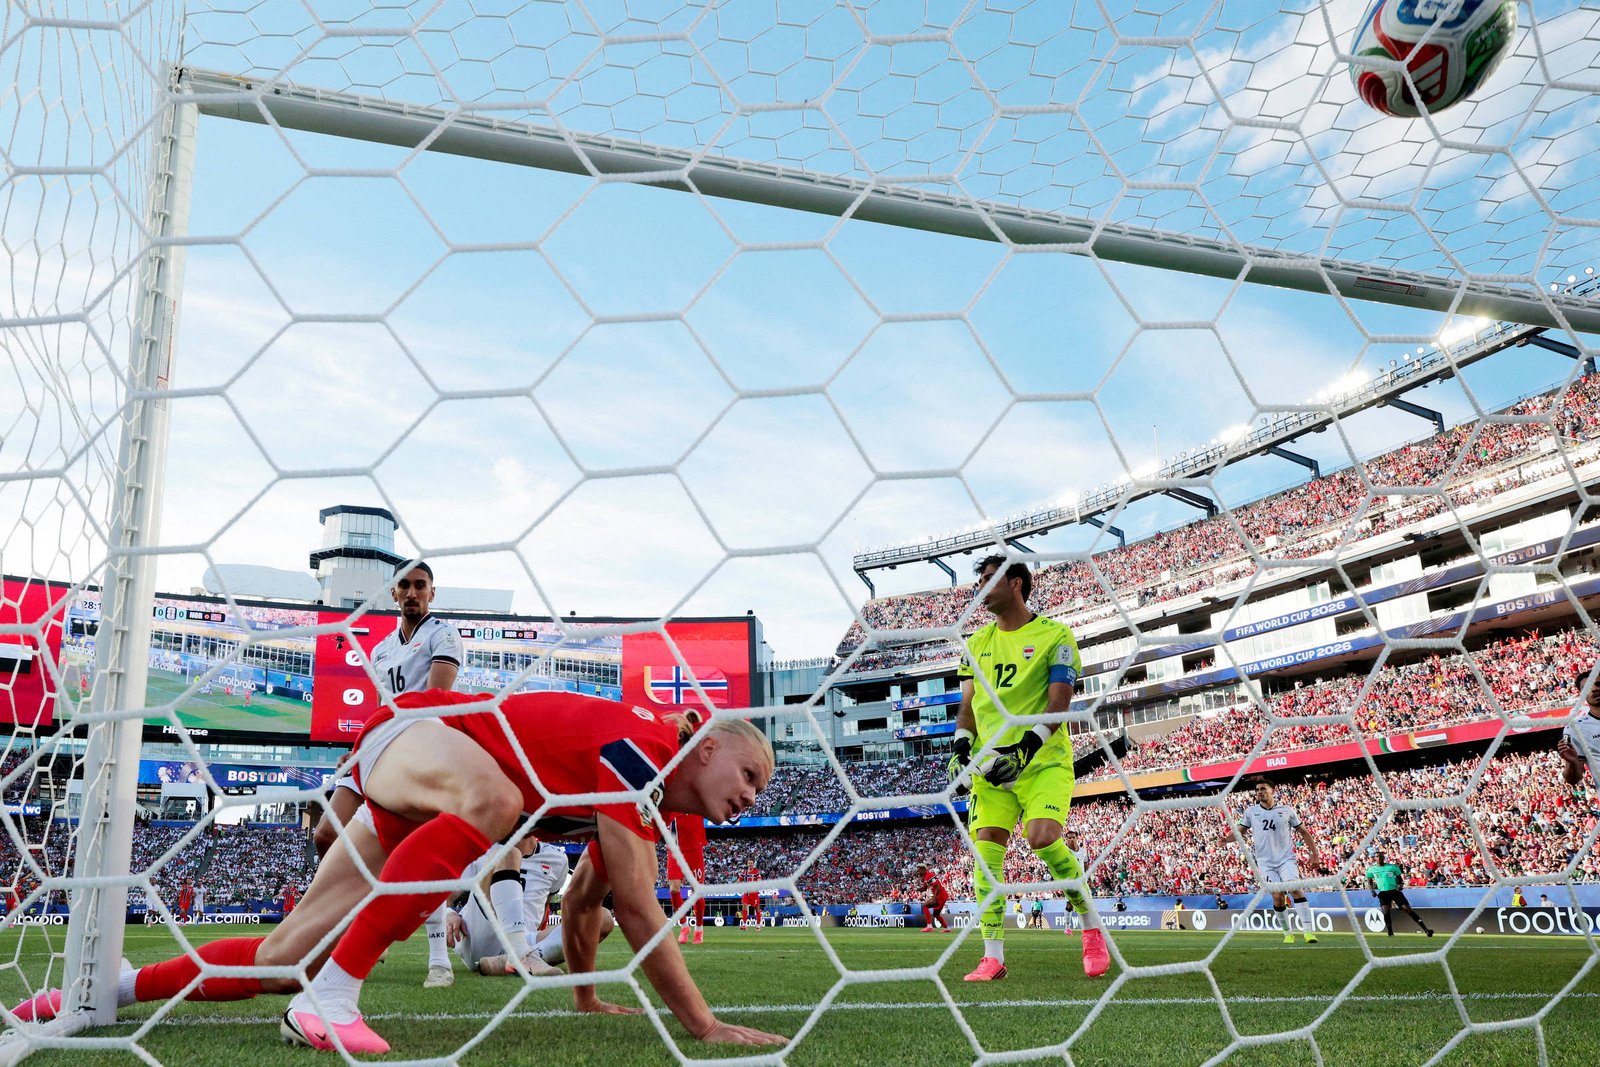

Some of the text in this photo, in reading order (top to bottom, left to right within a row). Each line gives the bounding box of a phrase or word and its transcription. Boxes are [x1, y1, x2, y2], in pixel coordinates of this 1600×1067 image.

[1489, 543, 1547, 567] BOSTON
[1496, 591, 1556, 615] BOSTON
[1235, 600, 1347, 637] FIFA WORLD CUP 2026
[1240, 641, 1352, 674] FIFA WORLD CUP 2026
[218, 675, 256, 690] motorola
[388, 665, 405, 694] 16
[994, 663, 1017, 689] 12
[1106, 690, 1139, 703] BOSTON
[162, 725, 209, 736] Hisnse
[1266, 756, 1287, 767] IRAQ
[228, 770, 288, 783] BOSTON
[1044, 804, 1060, 812] JAKO
[857, 810, 890, 820] BOSTON
[1262, 819, 1276, 831] 24
[693, 868, 702, 879] 10
[144, 912, 260, 925] fooball is calling
[879, 915, 905, 928] cang
[1055, 916, 1071, 926] FIF
[1101, 915, 1117, 926] CUP
[1118, 915, 1149, 926] 2026
[429, 931, 445, 939] JAKO
